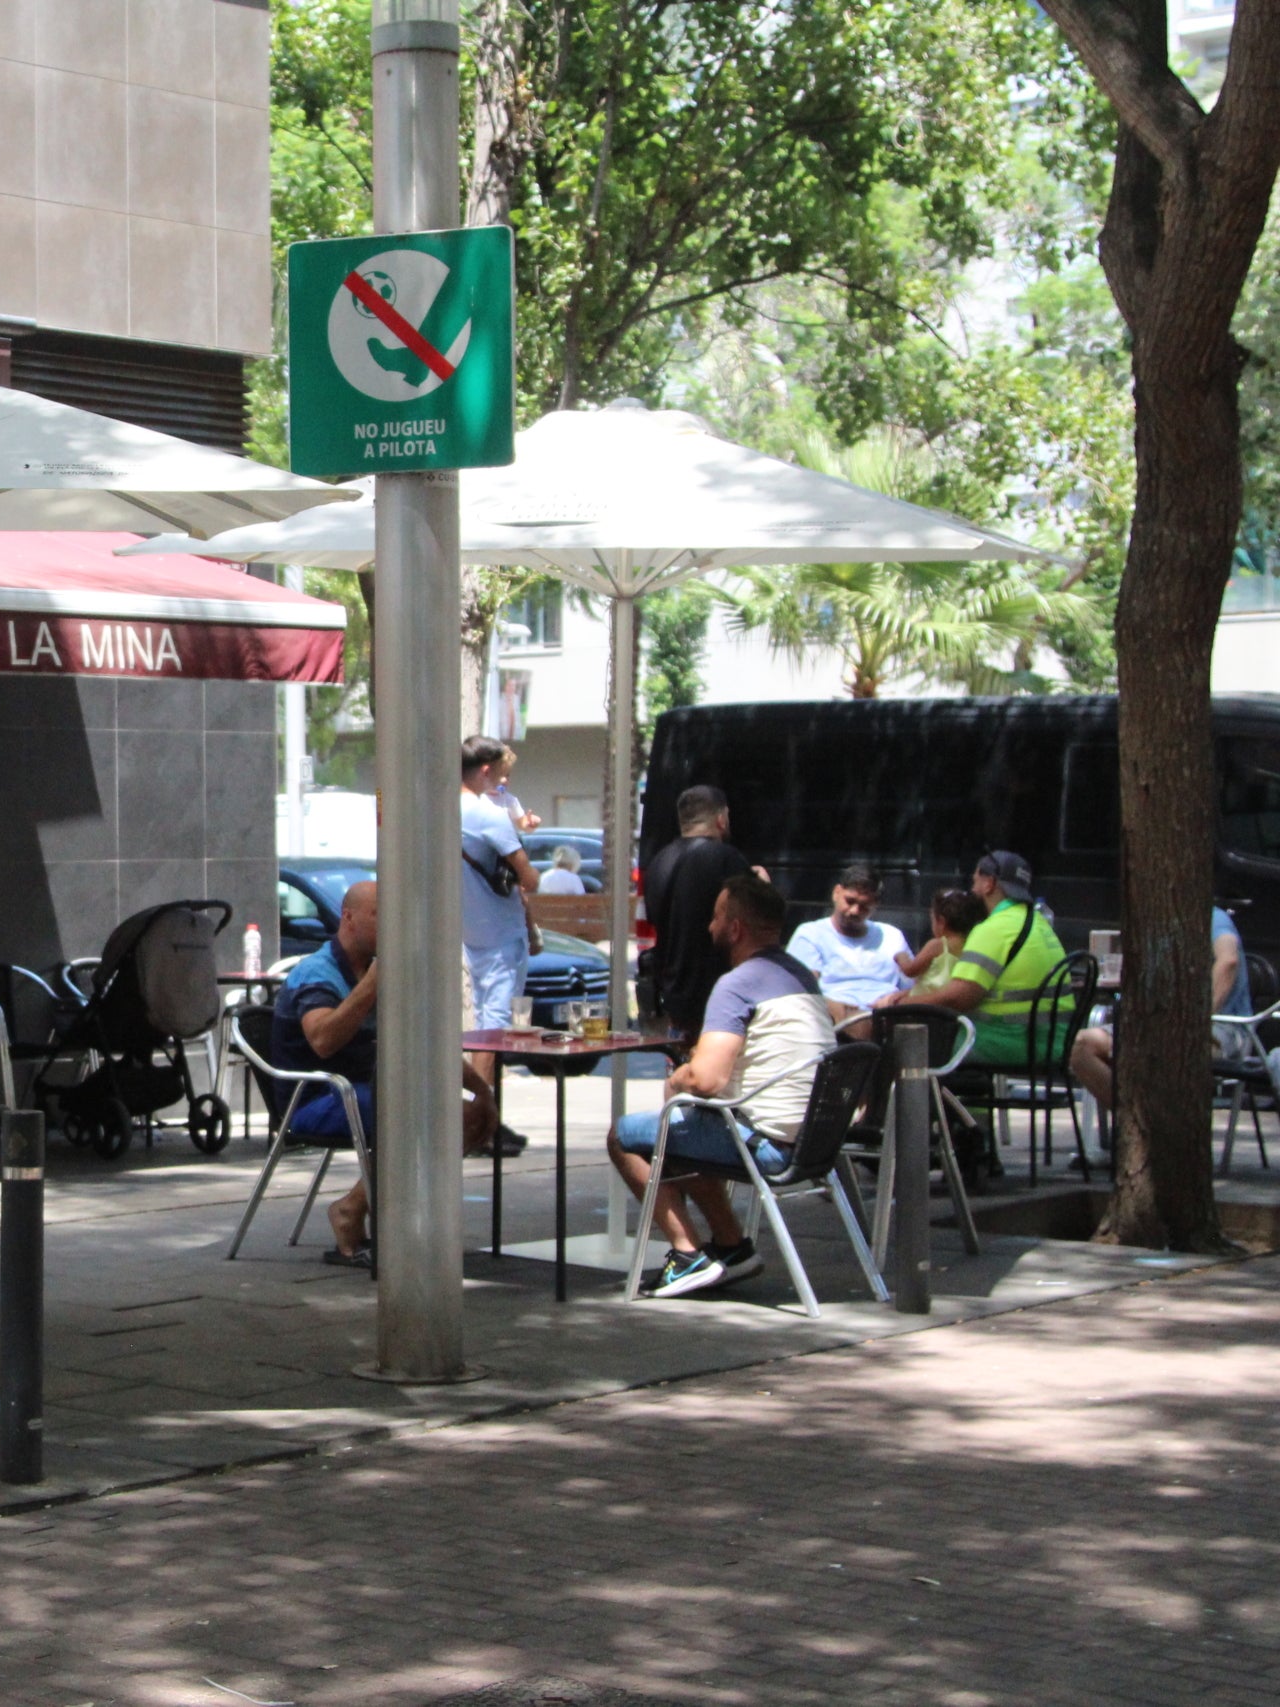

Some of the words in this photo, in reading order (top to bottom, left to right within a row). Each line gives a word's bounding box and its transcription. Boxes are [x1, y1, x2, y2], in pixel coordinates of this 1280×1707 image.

[354, 422, 378, 439] NO
[381, 418, 446, 438] JUGUEU
[363, 443, 375, 459] A
[378, 440, 437, 458] PILOTA
[8, 620, 62, 668] LA
[80, 623, 182, 672] MINA
